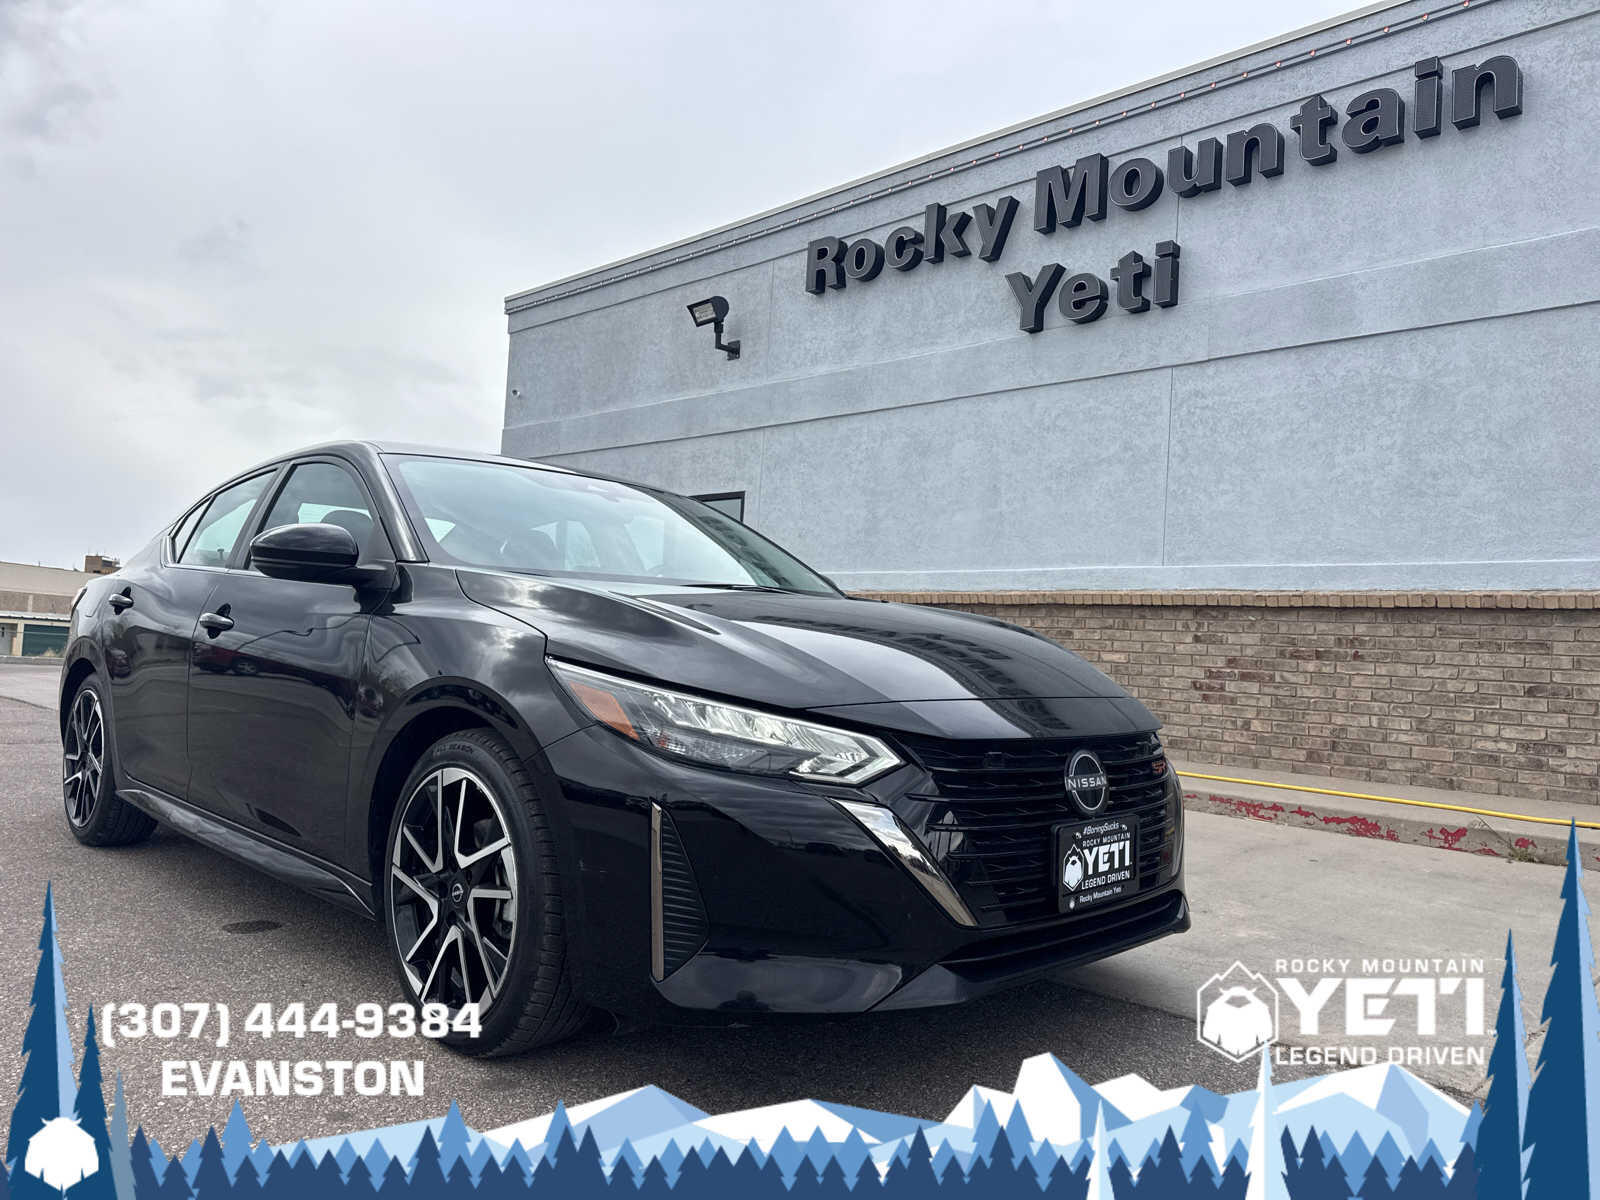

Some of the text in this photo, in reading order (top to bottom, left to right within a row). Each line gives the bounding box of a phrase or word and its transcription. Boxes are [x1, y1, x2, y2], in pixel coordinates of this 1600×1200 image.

[806, 53, 1524, 295] Rocky Mountain
[1005, 239, 1182, 334] Yeti
[1067, 776, 1107, 789] NISSAN
[1083, 832, 1131, 847] ROCKY MOUNTAIN
[1083, 840, 1131, 875] YETI
[1081, 870, 1130, 890] LEGEND DRIVEN
